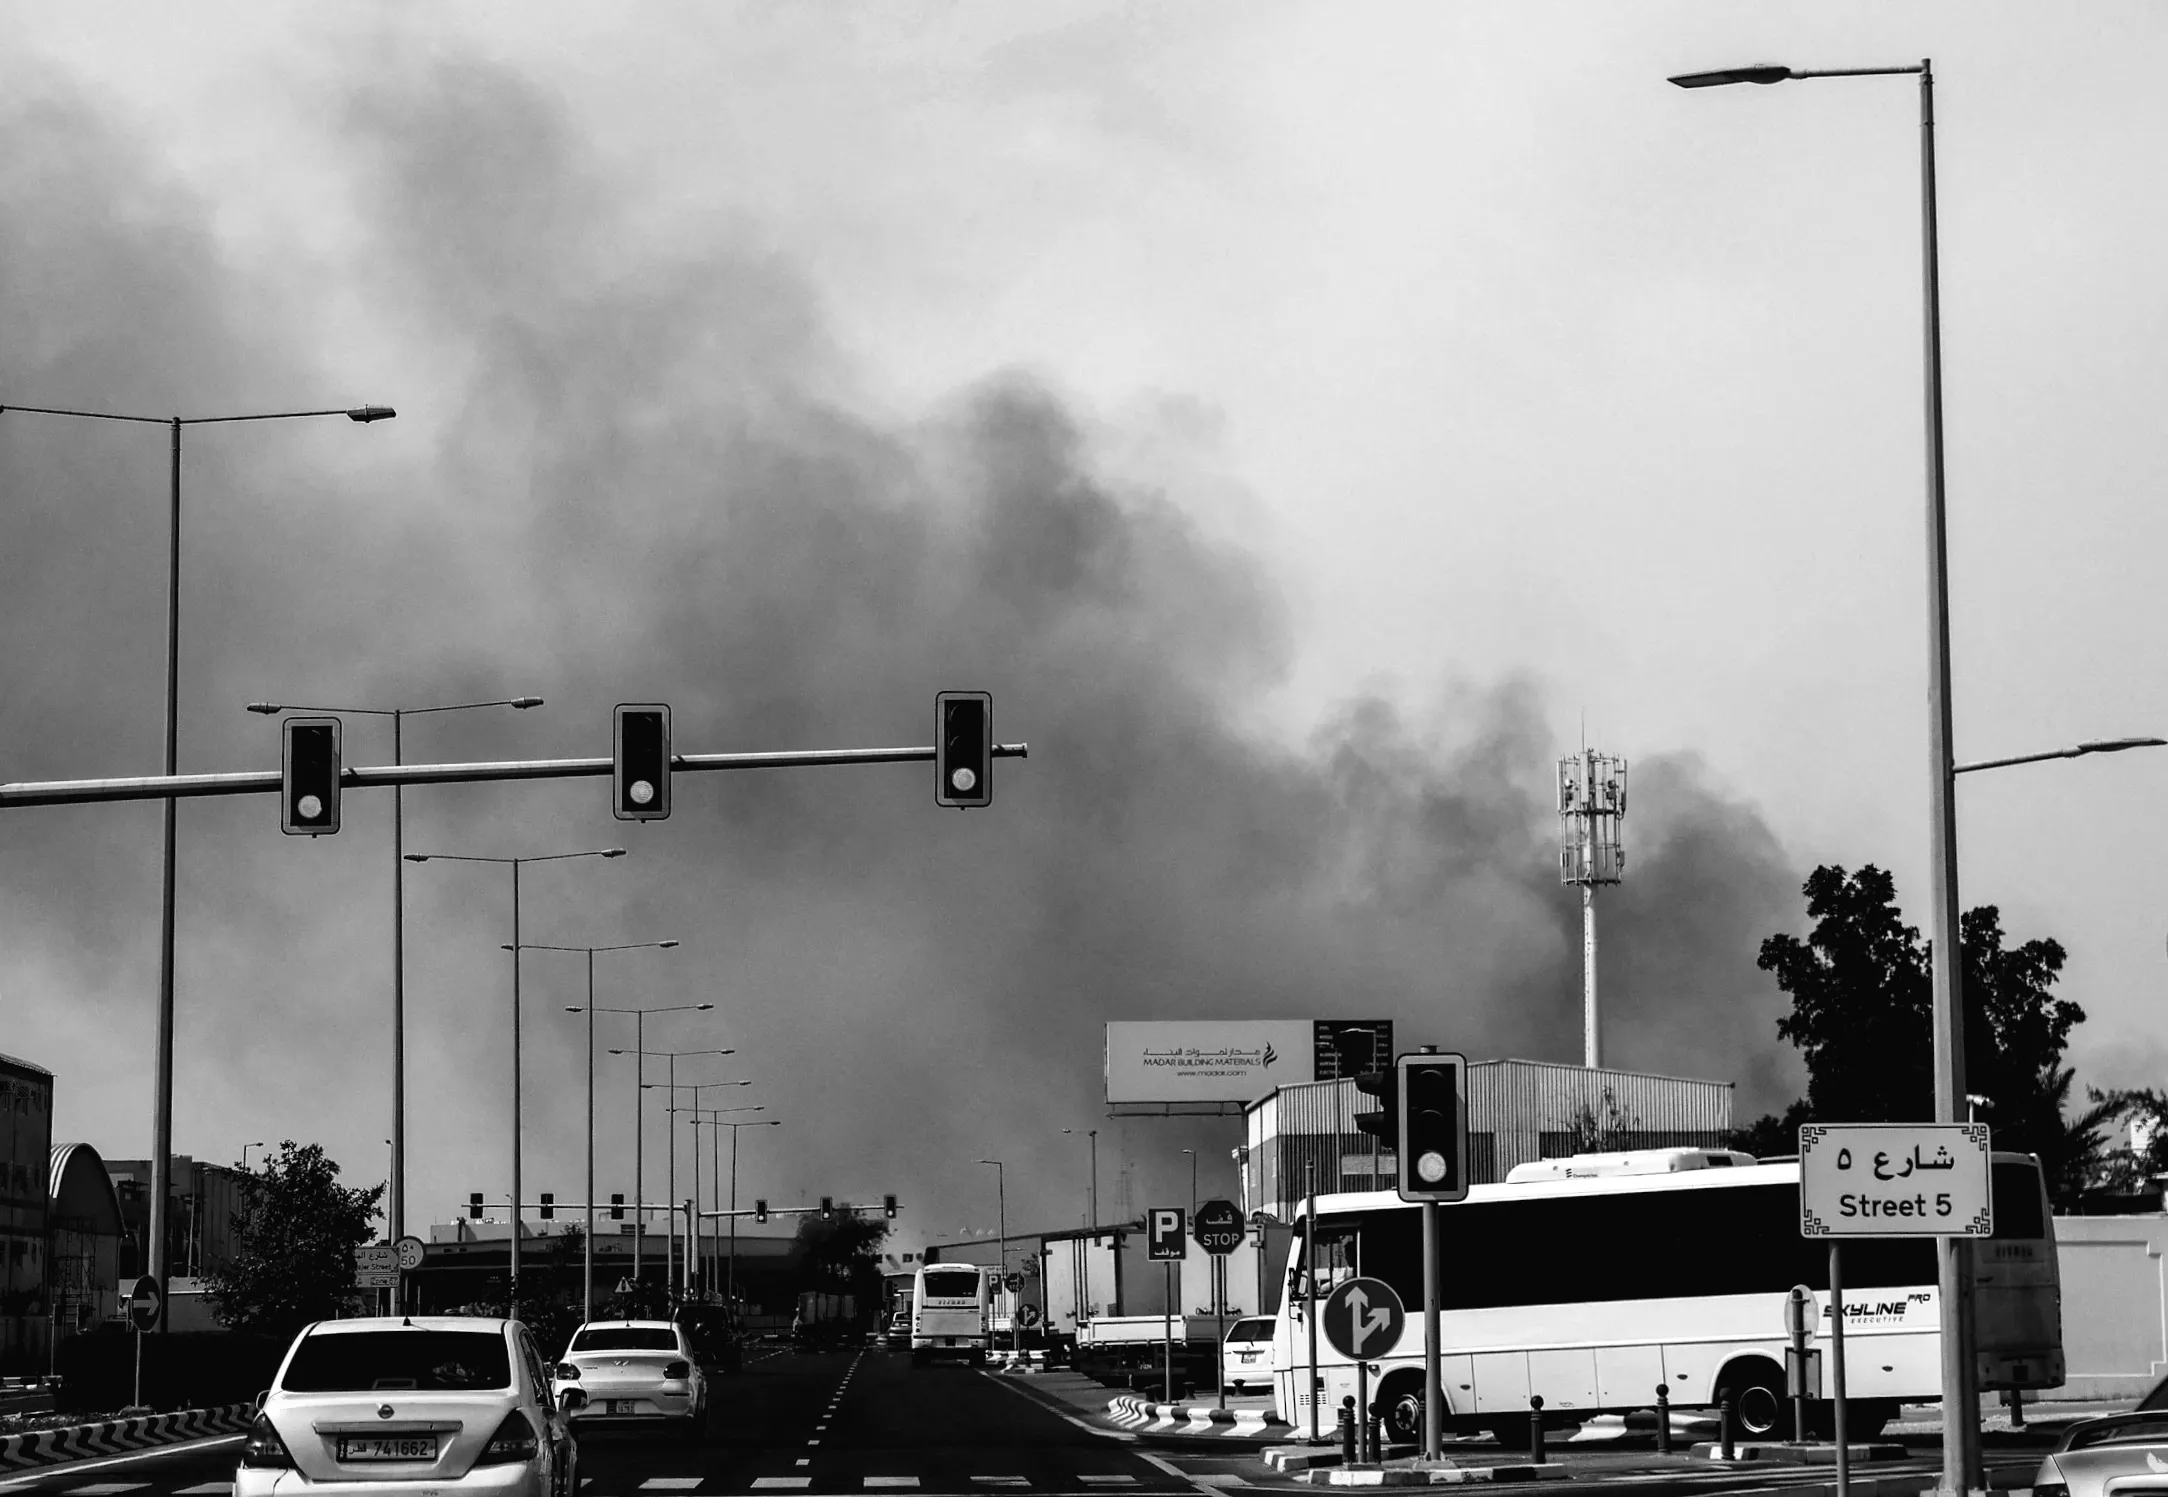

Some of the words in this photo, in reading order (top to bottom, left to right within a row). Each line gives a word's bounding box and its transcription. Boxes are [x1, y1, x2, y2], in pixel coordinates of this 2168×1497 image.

[1143, 1058, 1176, 1066] MADAR
[1177, 1058, 1214, 1066] BUILDING
[1214, 1058, 1261, 1066] MATERIALS
[1837, 1148, 1852, 1171] ٥
[1873, 1144, 1955, 1181] شارع
[1839, 1194, 1926, 1217] Street
[1935, 1193, 1952, 1216] 5
[1206, 1210, 1233, 1225] قف
[1155, 1211, 1179, 1243] P
[1203, 1233, 1240, 1246] STOP
[369, 1250, 388, 1261] شارع
[1154, 1247, 1181, 1257] موقف
[401, 1255, 416, 1265] 50
[371, 1263, 391, 1271] Street
[1907, 1293, 1931, 1304] PRO
[1851, 1315, 1904, 1324] EXECUTIVE
[373, 1440, 428, 1457] 741662
